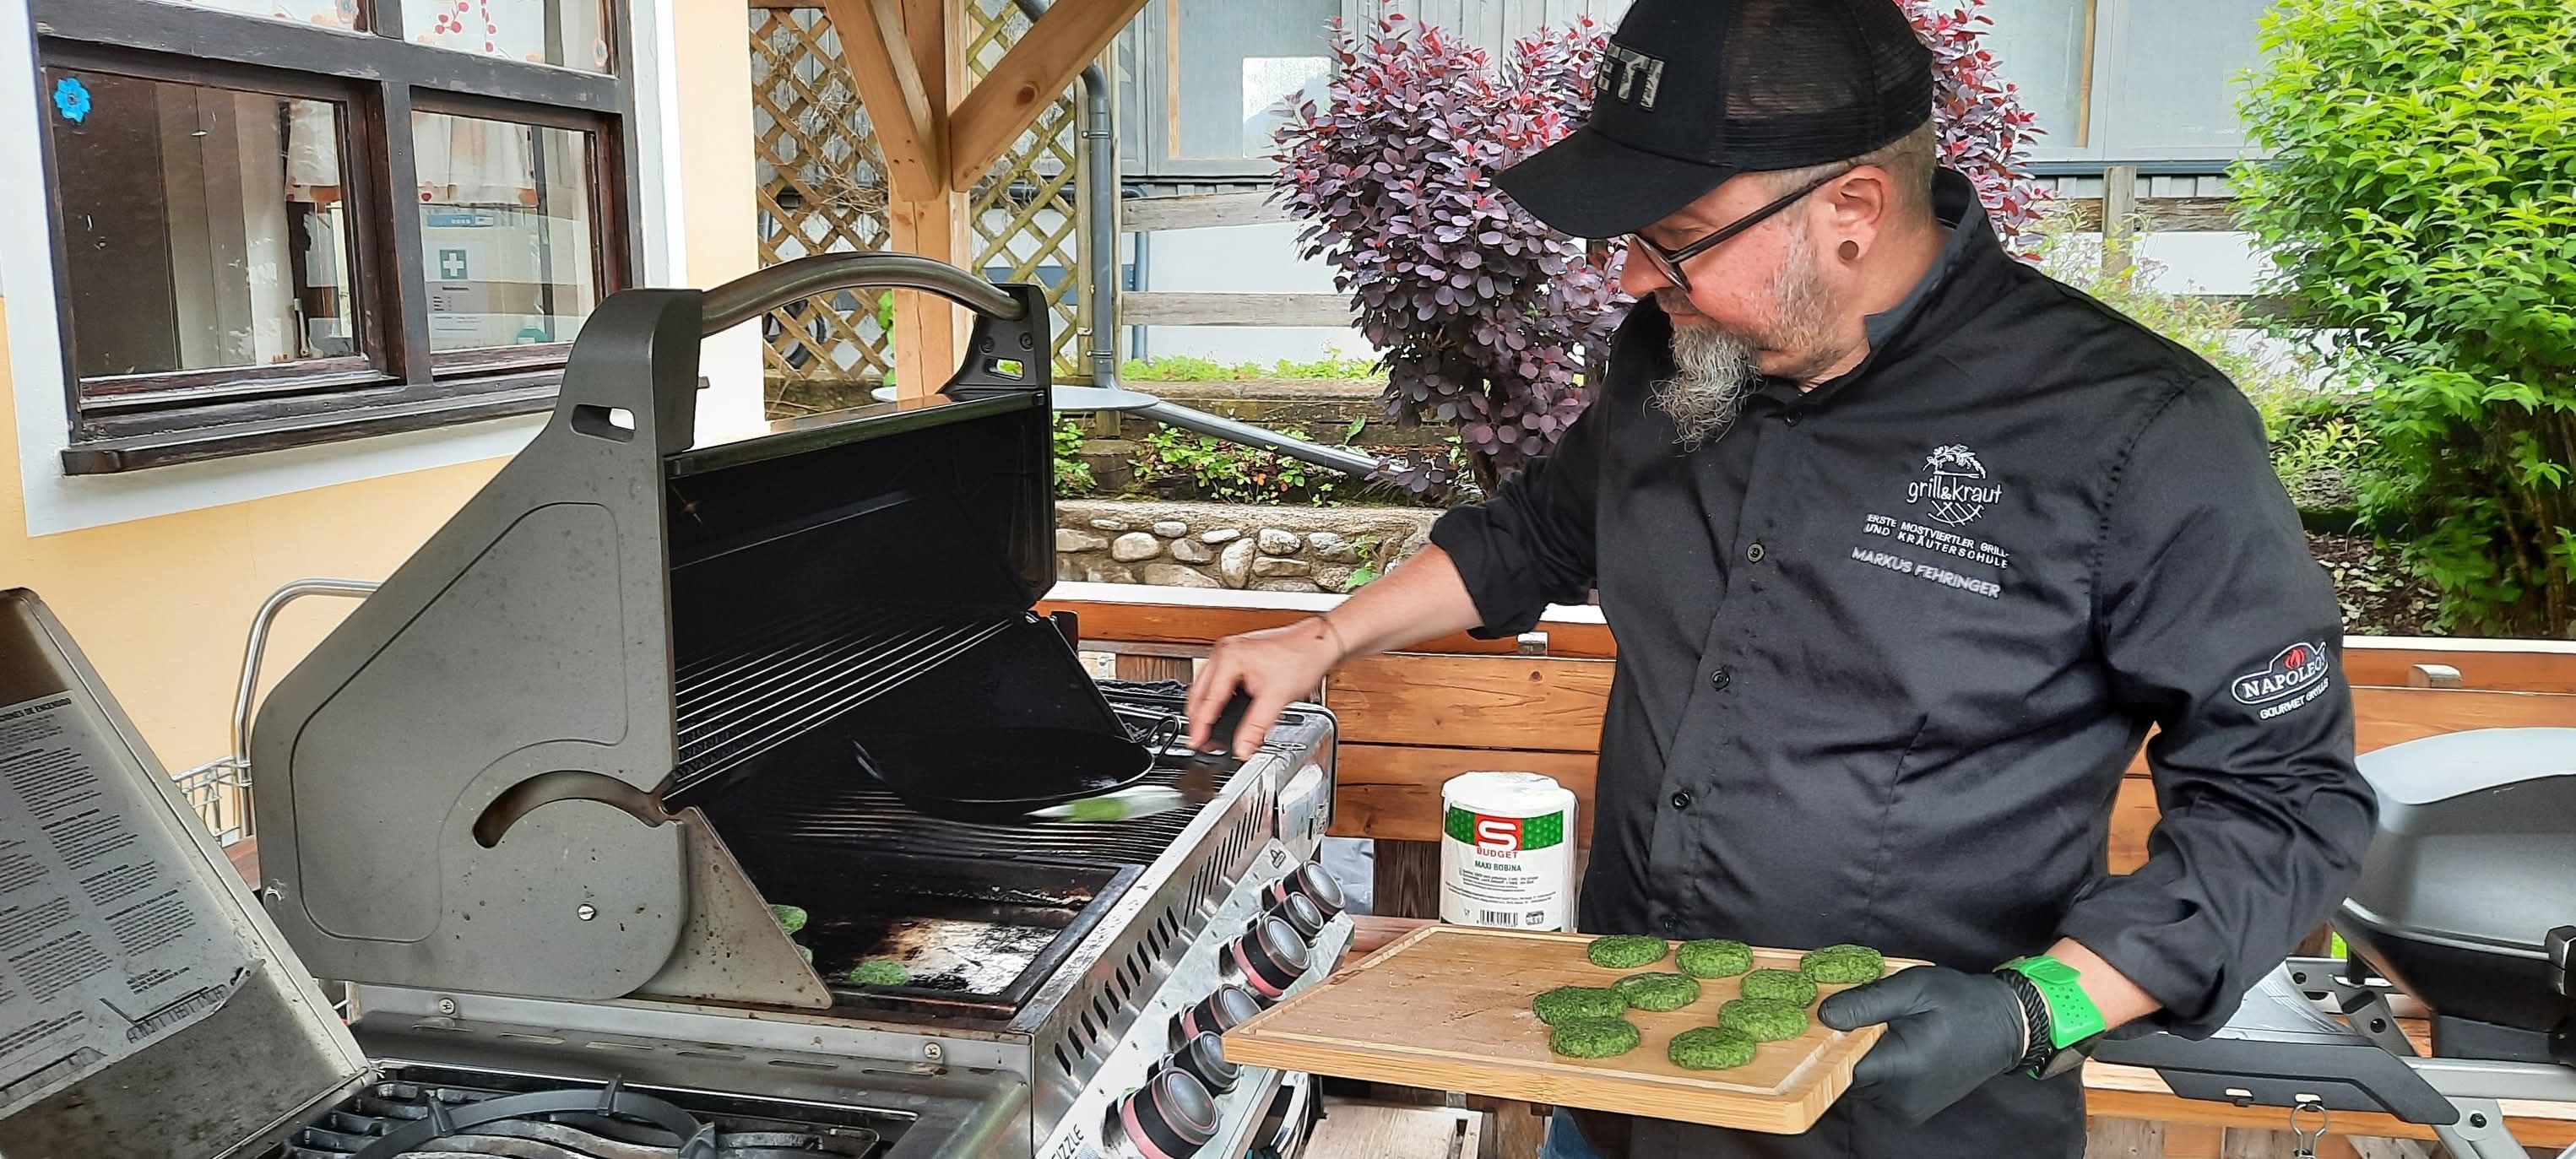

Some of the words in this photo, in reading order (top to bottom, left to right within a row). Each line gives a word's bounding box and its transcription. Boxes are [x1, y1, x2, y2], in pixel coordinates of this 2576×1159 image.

[1906, 476, 2003, 504] grill&kraut
[1863, 523, 1890, 536] UND
[1897, 533, 2009, 568] KRÄUTERSCHULE
[1867, 514, 1897, 528] ERSTE
[1901, 522, 1975, 549] MOSTVIERTLER
[1979, 543, 2010, 558] GRILL-
[1851, 547, 1913, 573] MARKUS
[1914, 565, 2001, 598] FEHRINGER
[2260, 694, 2306, 719] GOURMET
[2306, 678, 2329, 701] GRILLS
[1476, 848, 1519, 858] BUDGET
[1478, 820, 1518, 851] S
[1474, 860, 1492, 870] MAXI
